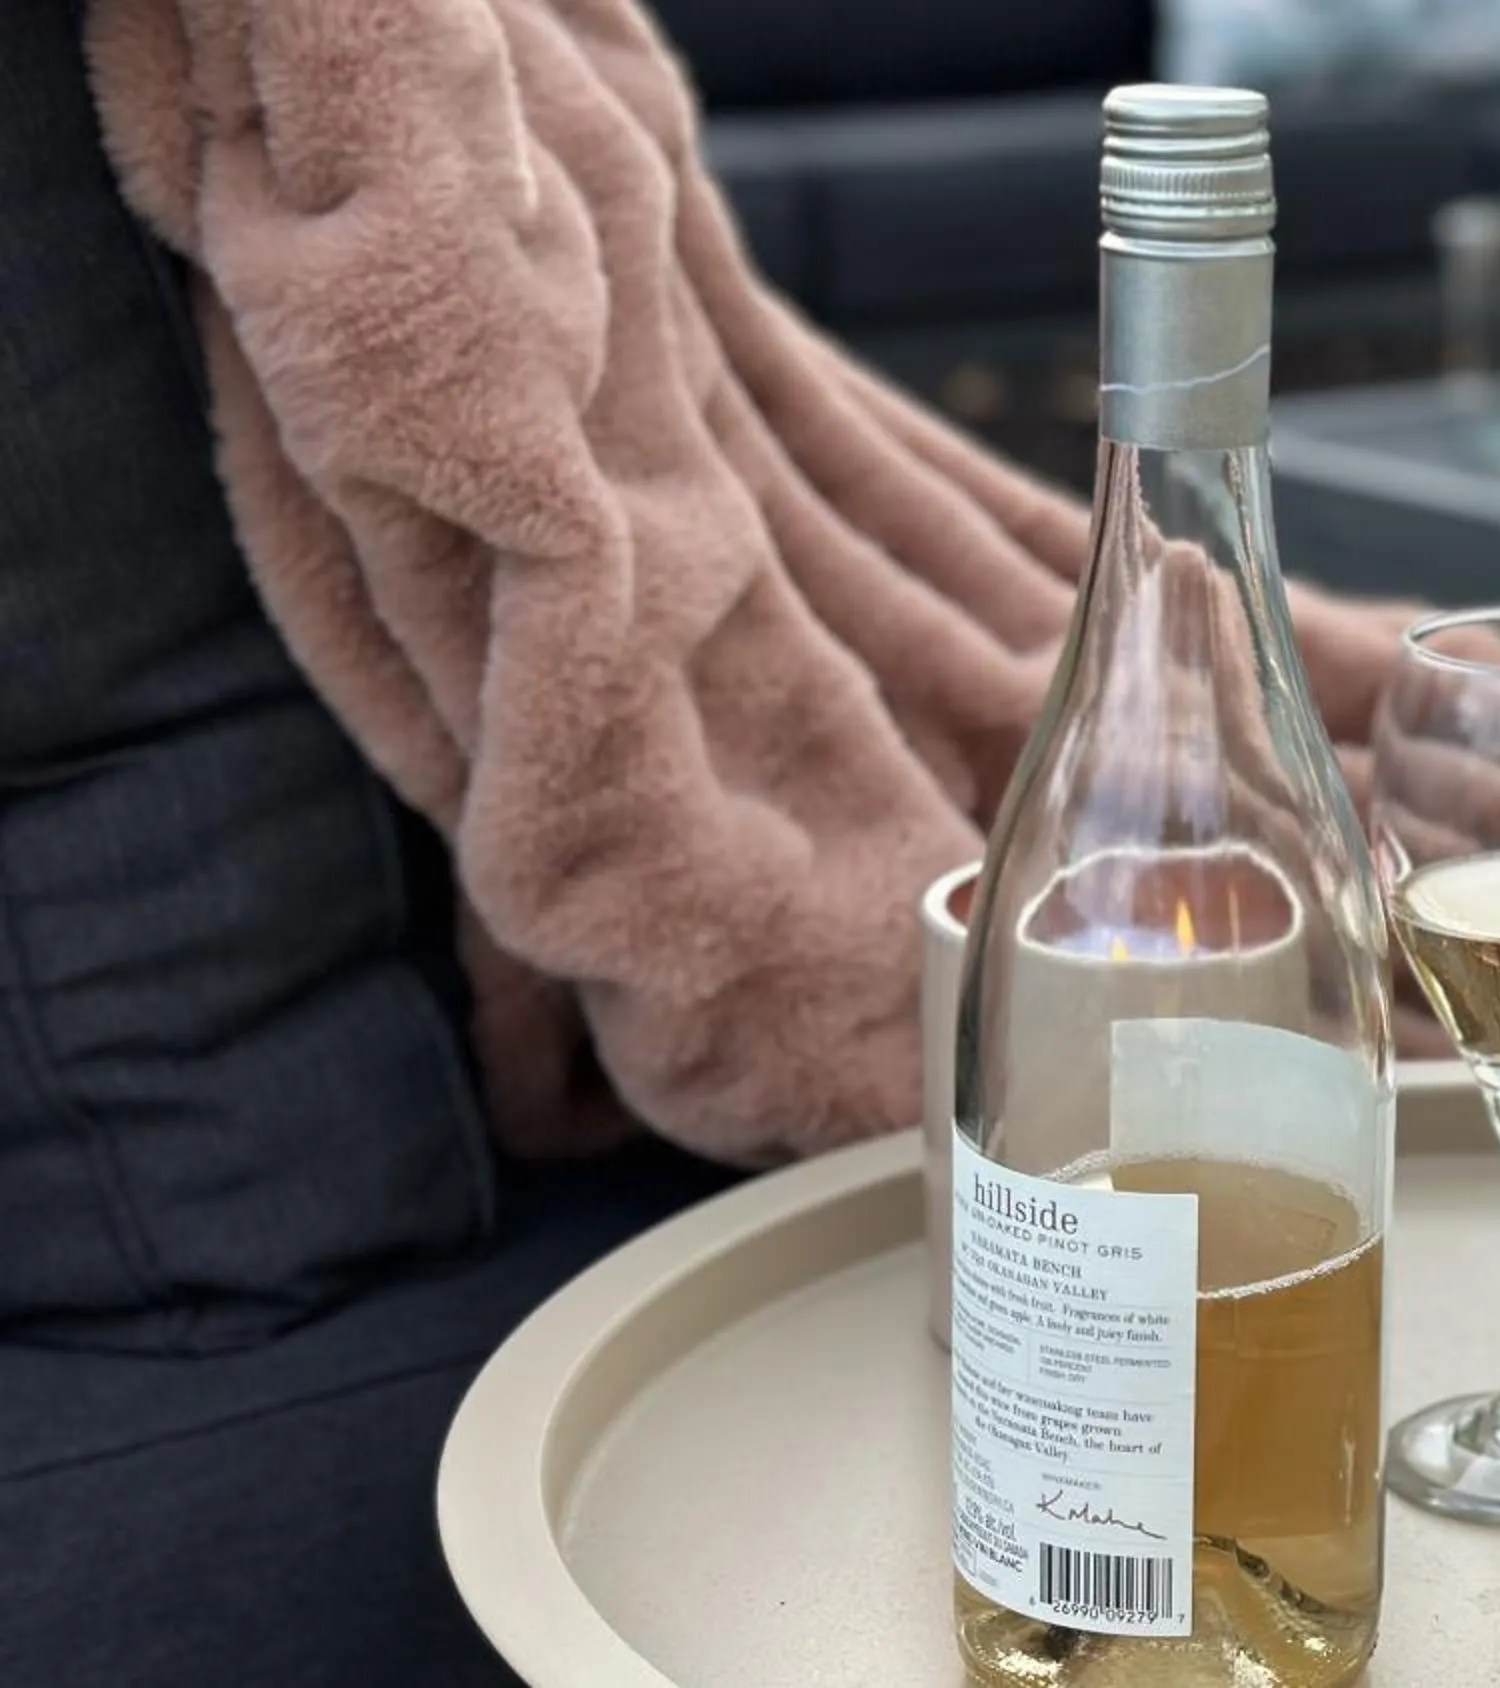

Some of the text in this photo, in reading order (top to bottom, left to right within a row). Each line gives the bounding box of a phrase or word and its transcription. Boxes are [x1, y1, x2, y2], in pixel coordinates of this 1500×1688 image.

[974, 1172, 1079, 1235] hillside
[1037, 1232, 1089, 1254] PINOT
[1097, 1244, 1144, 1261] GRIS
[1032, 1256, 1082, 1279] BENCH
[1053, 1280, 1108, 1302] VALLEY
[1063, 1303, 1121, 1323] Fragrances
[1123, 1311, 1135, 1325] of
[1137, 1312, 1171, 1326] white
[1035, 1314, 1045, 1328] A
[1075, 1323, 1095, 1338] and
[1096, 1326, 1124, 1343] juicy
[1015, 1390, 1084, 1419] winemaking
[1087, 1407, 1119, 1421] team
[1122, 1408, 1153, 1422] have
[1012, 1403, 1039, 1420] from
[1041, 1415, 1079, 1431] grapes
[1081, 1423, 1122, 1437] grown
[1083, 1437, 1105, 1449] the
[1108, 1439, 1144, 1454] heart
[1148, 1441, 1163, 1455] of
[989, 1547, 1023, 1573] BLANC
[1053, 1599, 1099, 1620] 26990
[1105, 1608, 1158, 1624] 09279
[1177, 1613, 1185, 1624] 7
